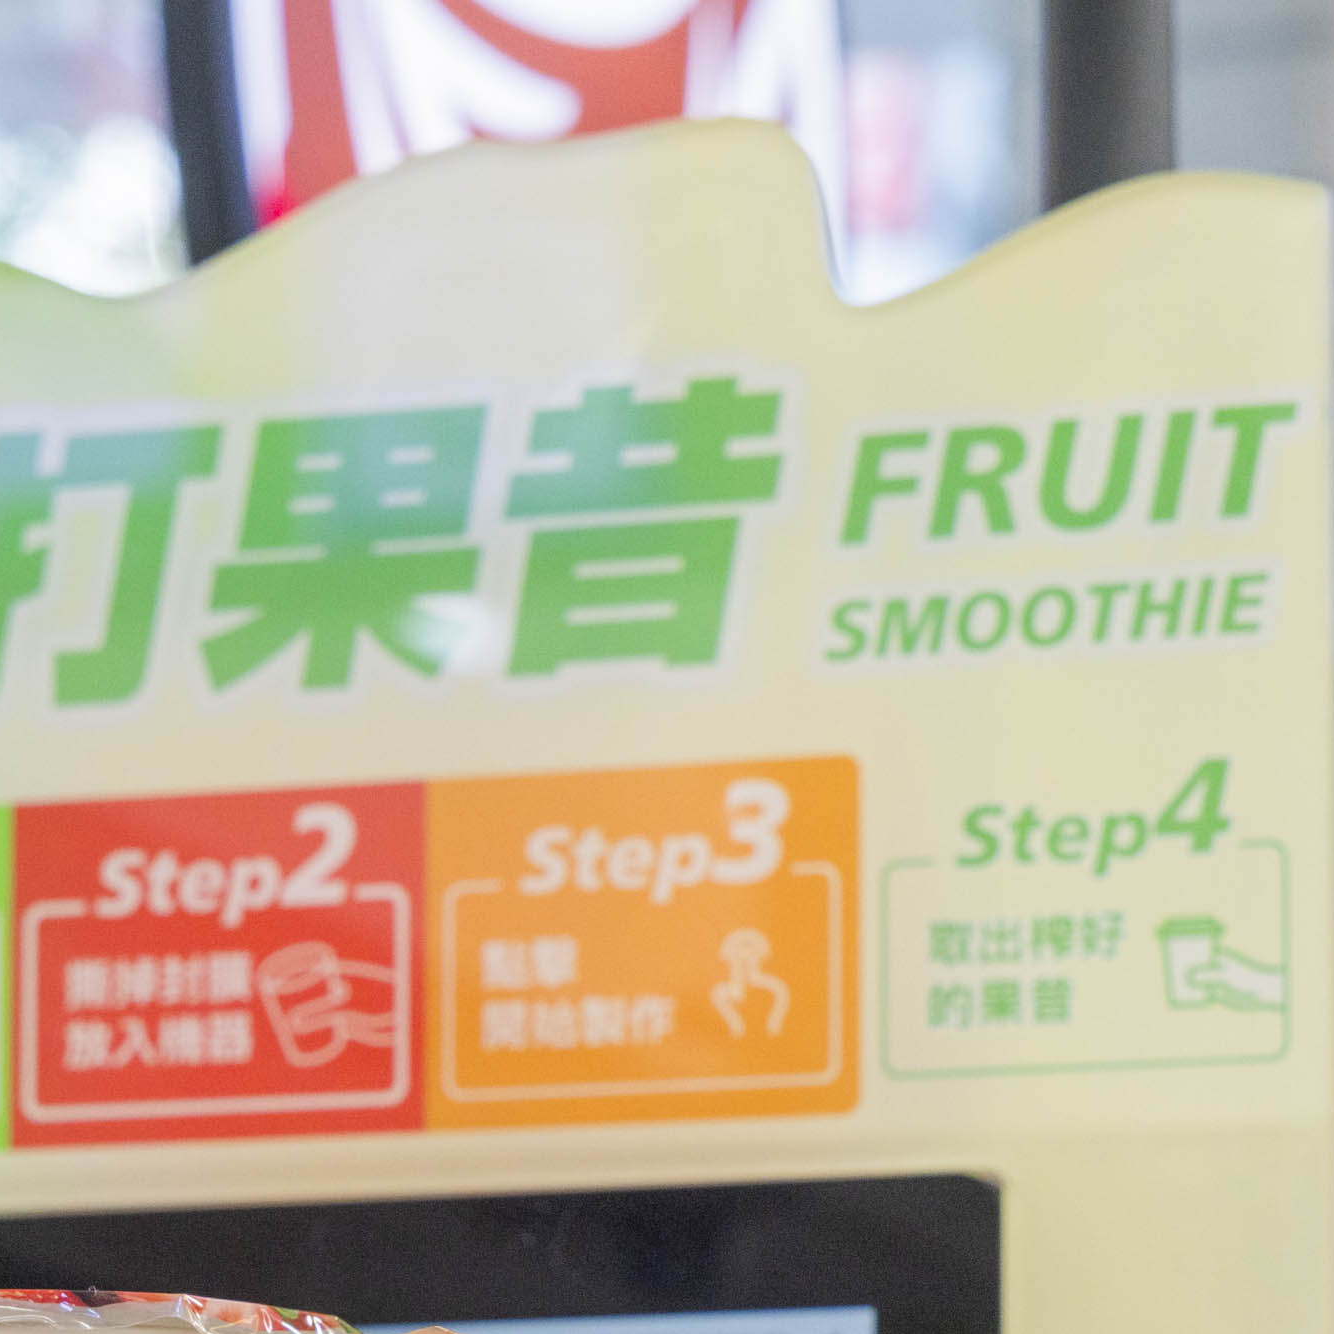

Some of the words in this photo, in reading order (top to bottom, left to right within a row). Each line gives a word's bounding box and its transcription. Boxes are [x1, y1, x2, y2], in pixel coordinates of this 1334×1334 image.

[838, 402, 1297, 548] FRUIT
[823, 571, 1269, 662] SMOOTHIE
[94, 802, 359, 930] Step2
[518, 778, 791, 905] Step3
[954, 755, 1232, 877] Step4
